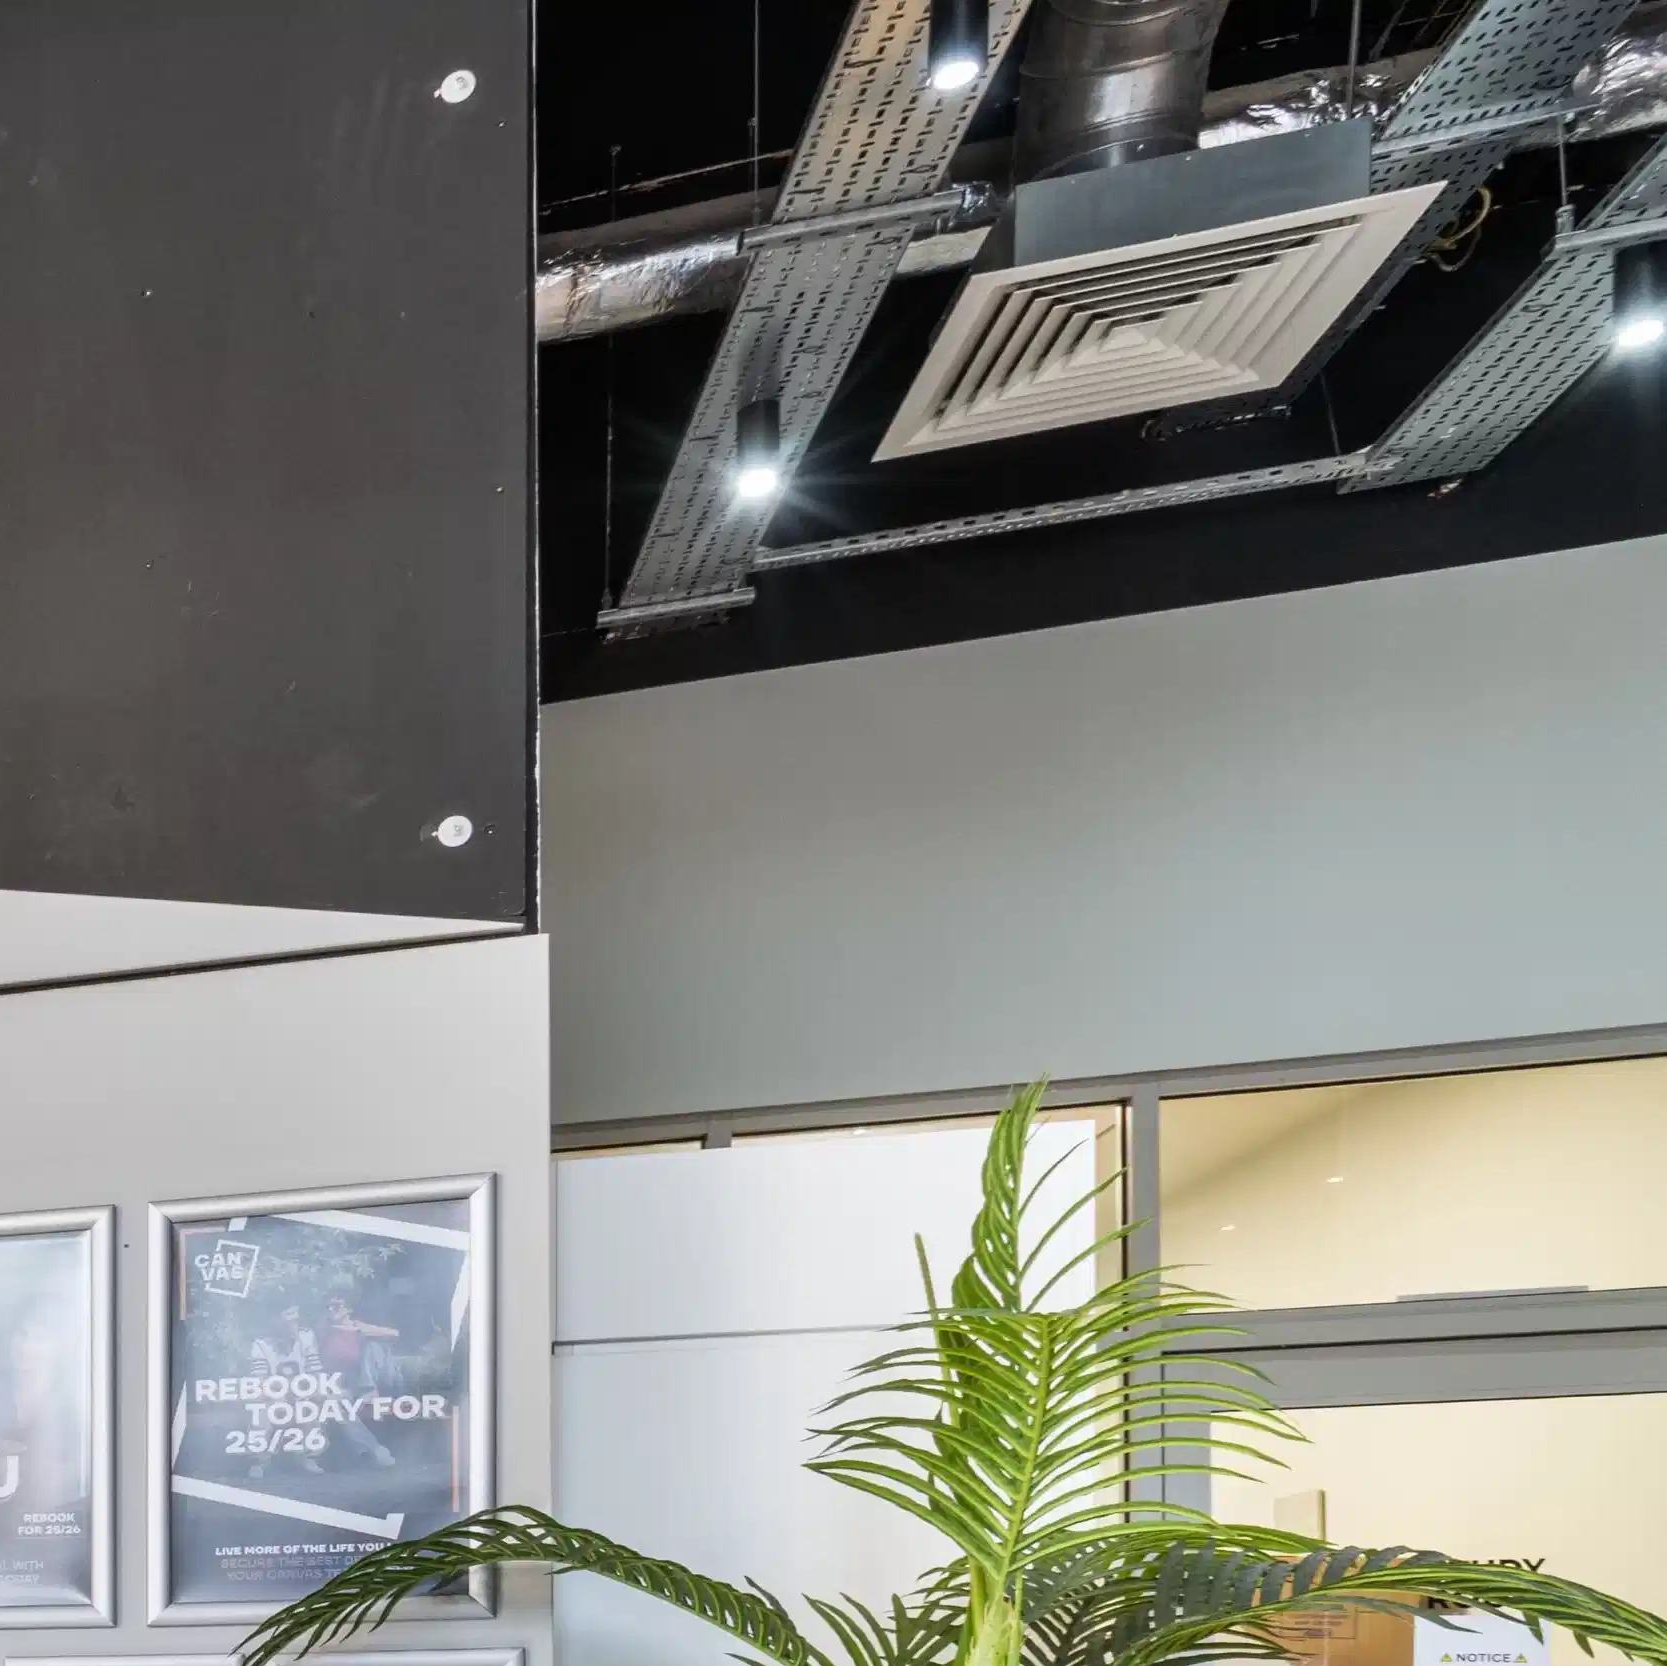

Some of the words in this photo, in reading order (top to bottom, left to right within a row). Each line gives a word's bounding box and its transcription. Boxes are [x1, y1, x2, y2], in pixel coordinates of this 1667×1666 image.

[194, 1251, 242, 1267] CAN
[201, 1267, 244, 1282] VAS
[195, 1372, 344, 1402] REBOOK
[245, 1400, 364, 1426] TODAY
[372, 1394, 447, 1420] FOR
[225, 1427, 327, 1454] 25/26
[23, 1512, 75, 1524] REBOOK
[17, 1525, 42, 1536] FOR
[44, 1524, 81, 1536] 25/26
[215, 1547, 241, 1556] LIVE
[244, 1546, 280, 1555] MORE
[282, 1545, 299, 1554] OF
[302, 1545, 326, 1554] THE
[329, 1544, 354, 1553] LIFE
[357, 1543, 384, 1552] YOU
[1456, 1653, 1512, 1663] NOTICE
